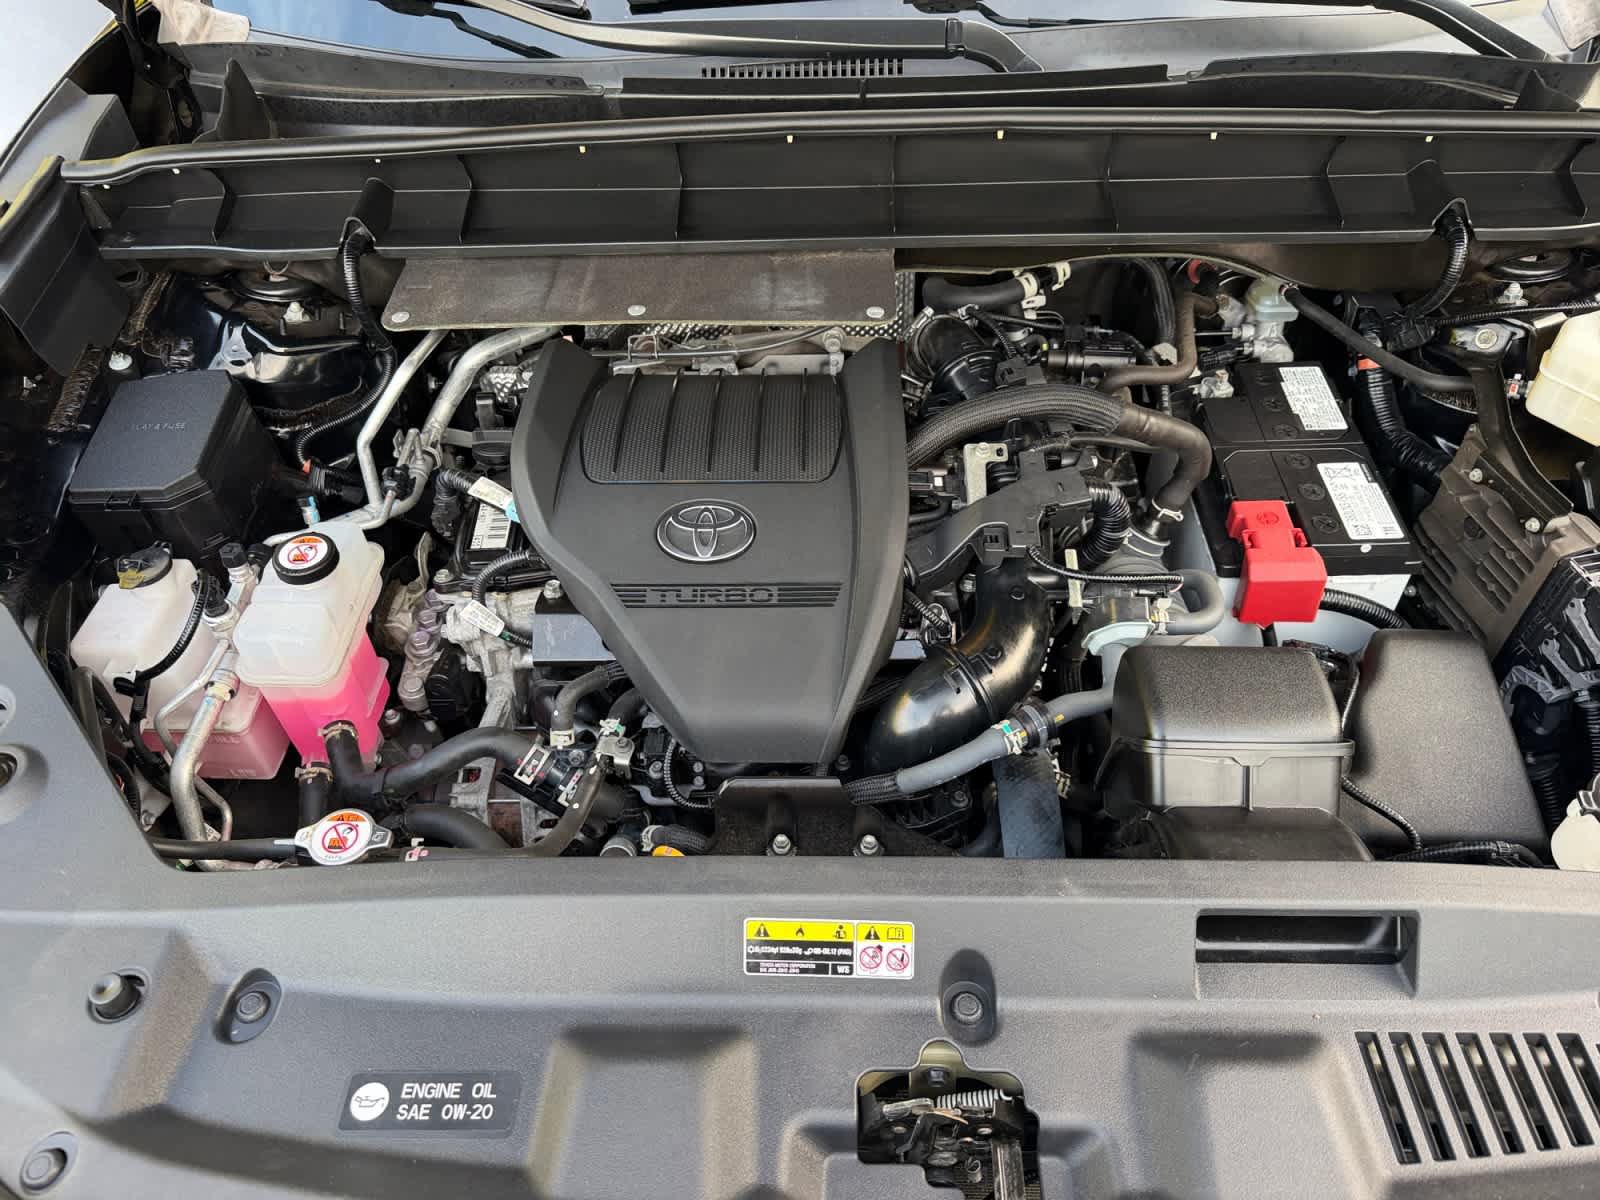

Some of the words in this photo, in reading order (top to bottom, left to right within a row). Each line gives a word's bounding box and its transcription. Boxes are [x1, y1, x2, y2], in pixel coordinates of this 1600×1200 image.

[649, 587, 776, 603] TURBO
[401, 1082, 463, 1099] ENGINE
[471, 1082, 497, 1099] OIL
[396, 1103, 432, 1121] SAE
[441, 1103, 494, 1121] 0W-20
